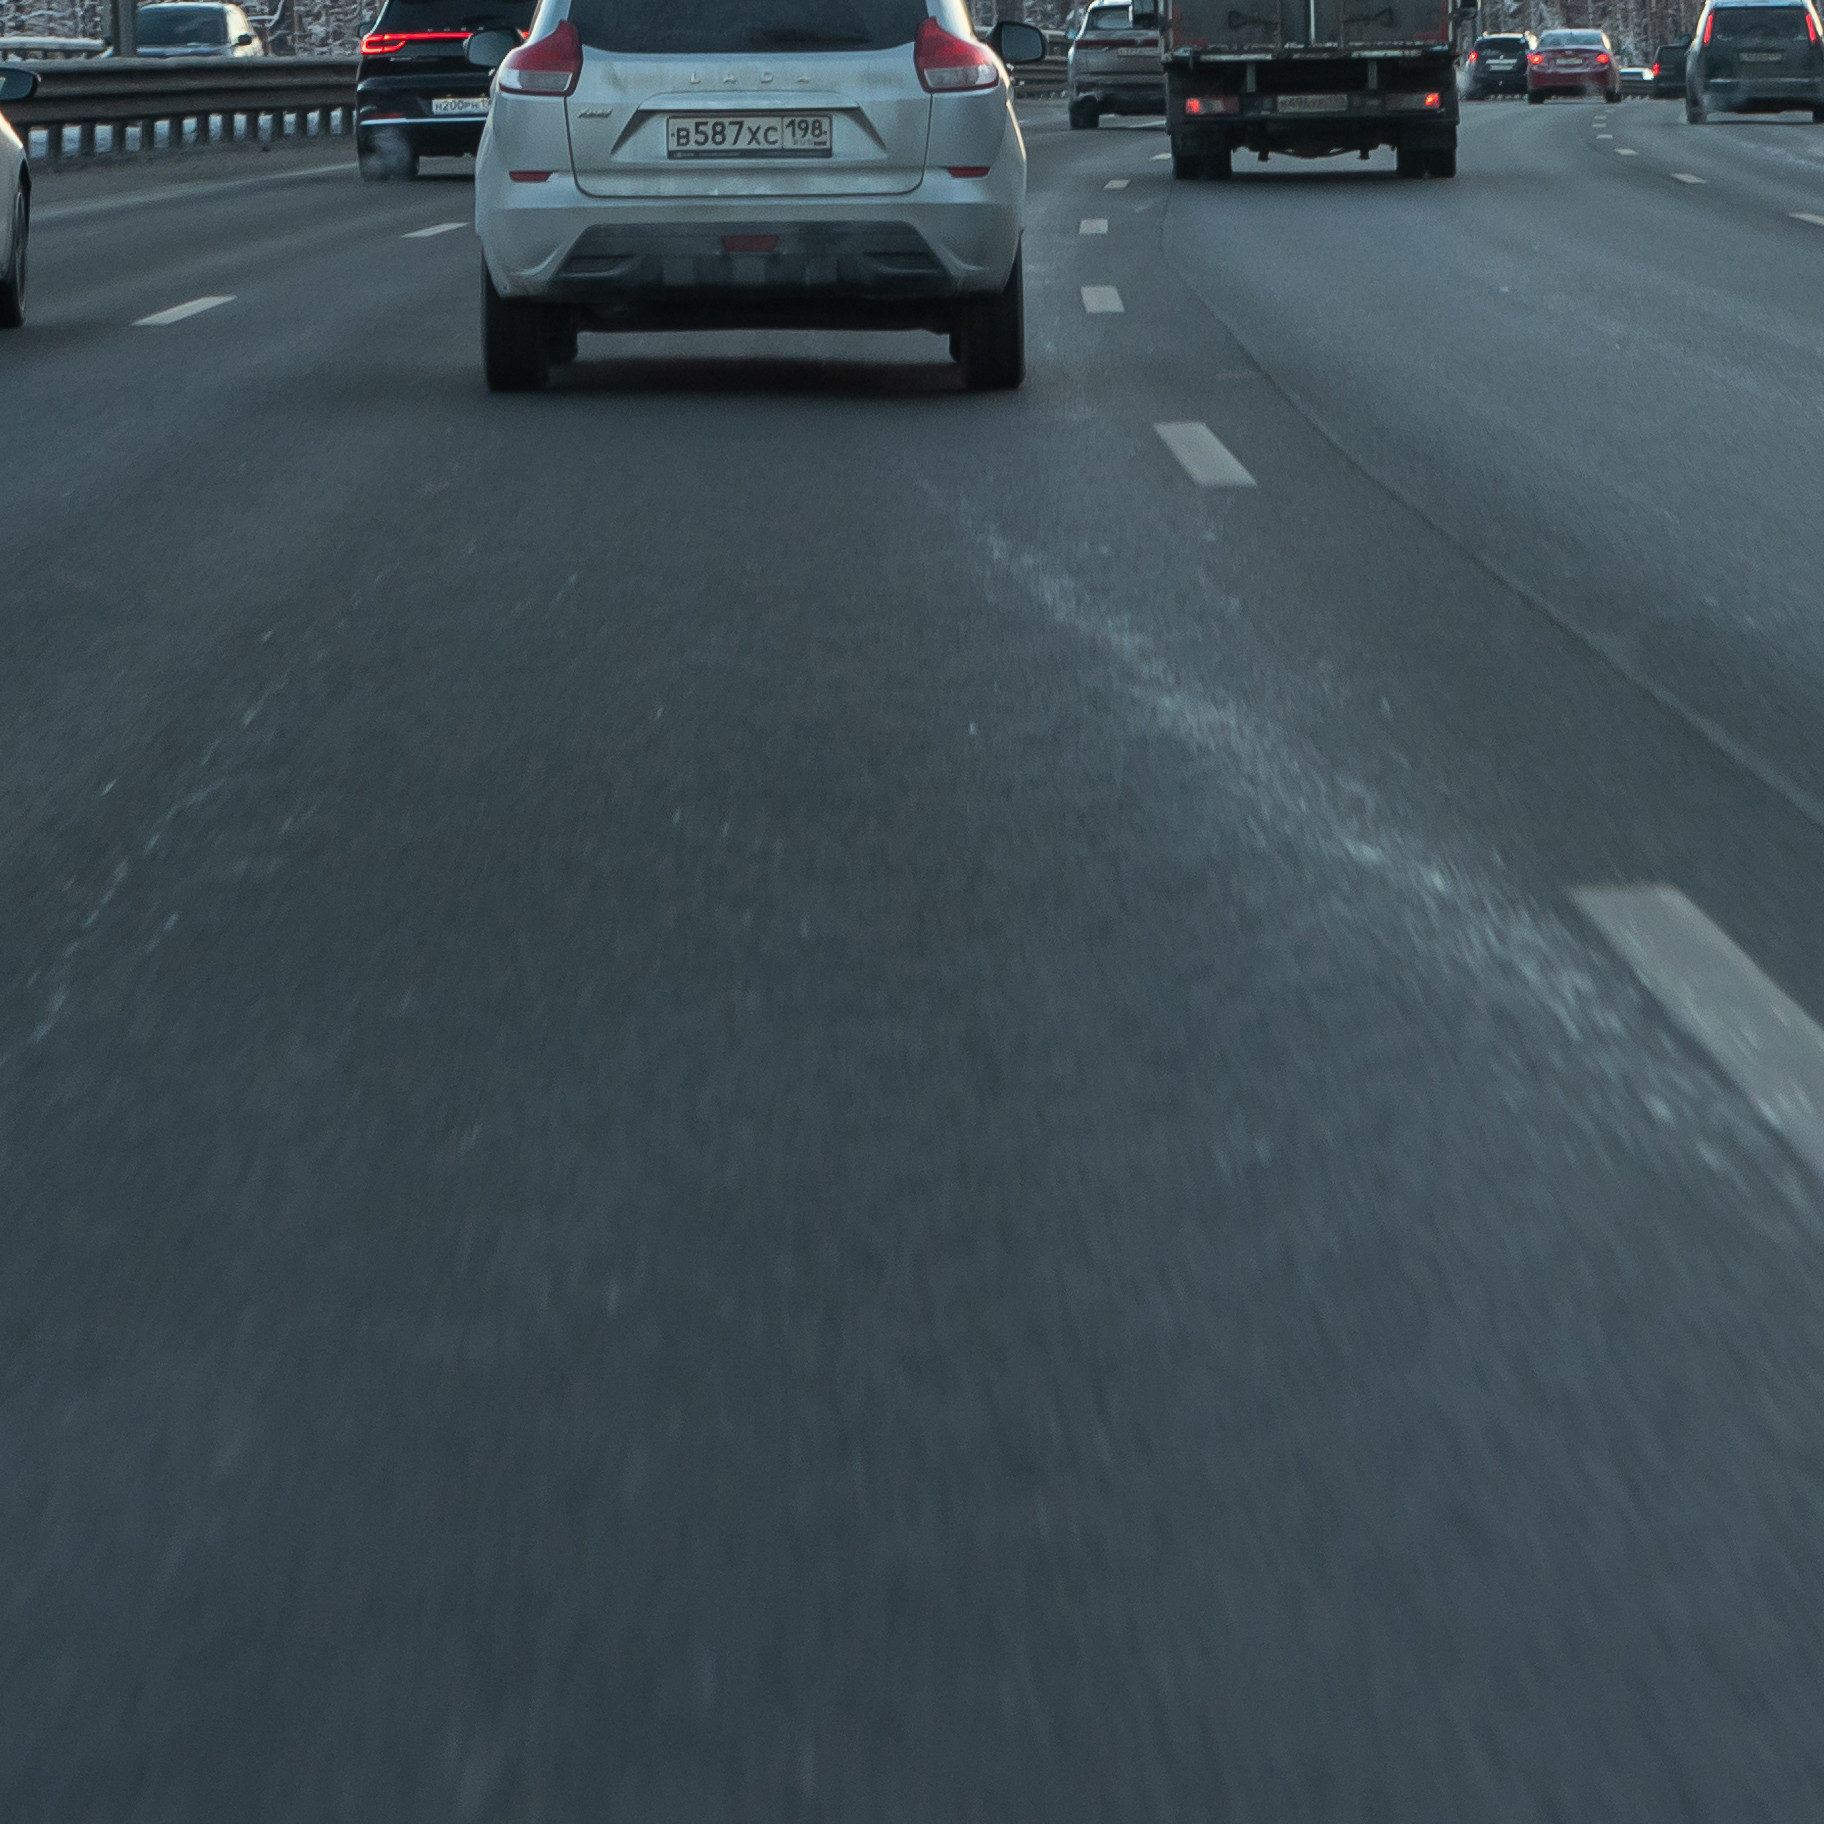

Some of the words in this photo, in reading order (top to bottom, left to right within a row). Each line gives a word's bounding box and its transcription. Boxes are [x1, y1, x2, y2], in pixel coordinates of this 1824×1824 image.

[689, 71, 810, 85] LADA
[675, 119, 780, 147] В587ХС
[784, 118, 824, 138] 198
